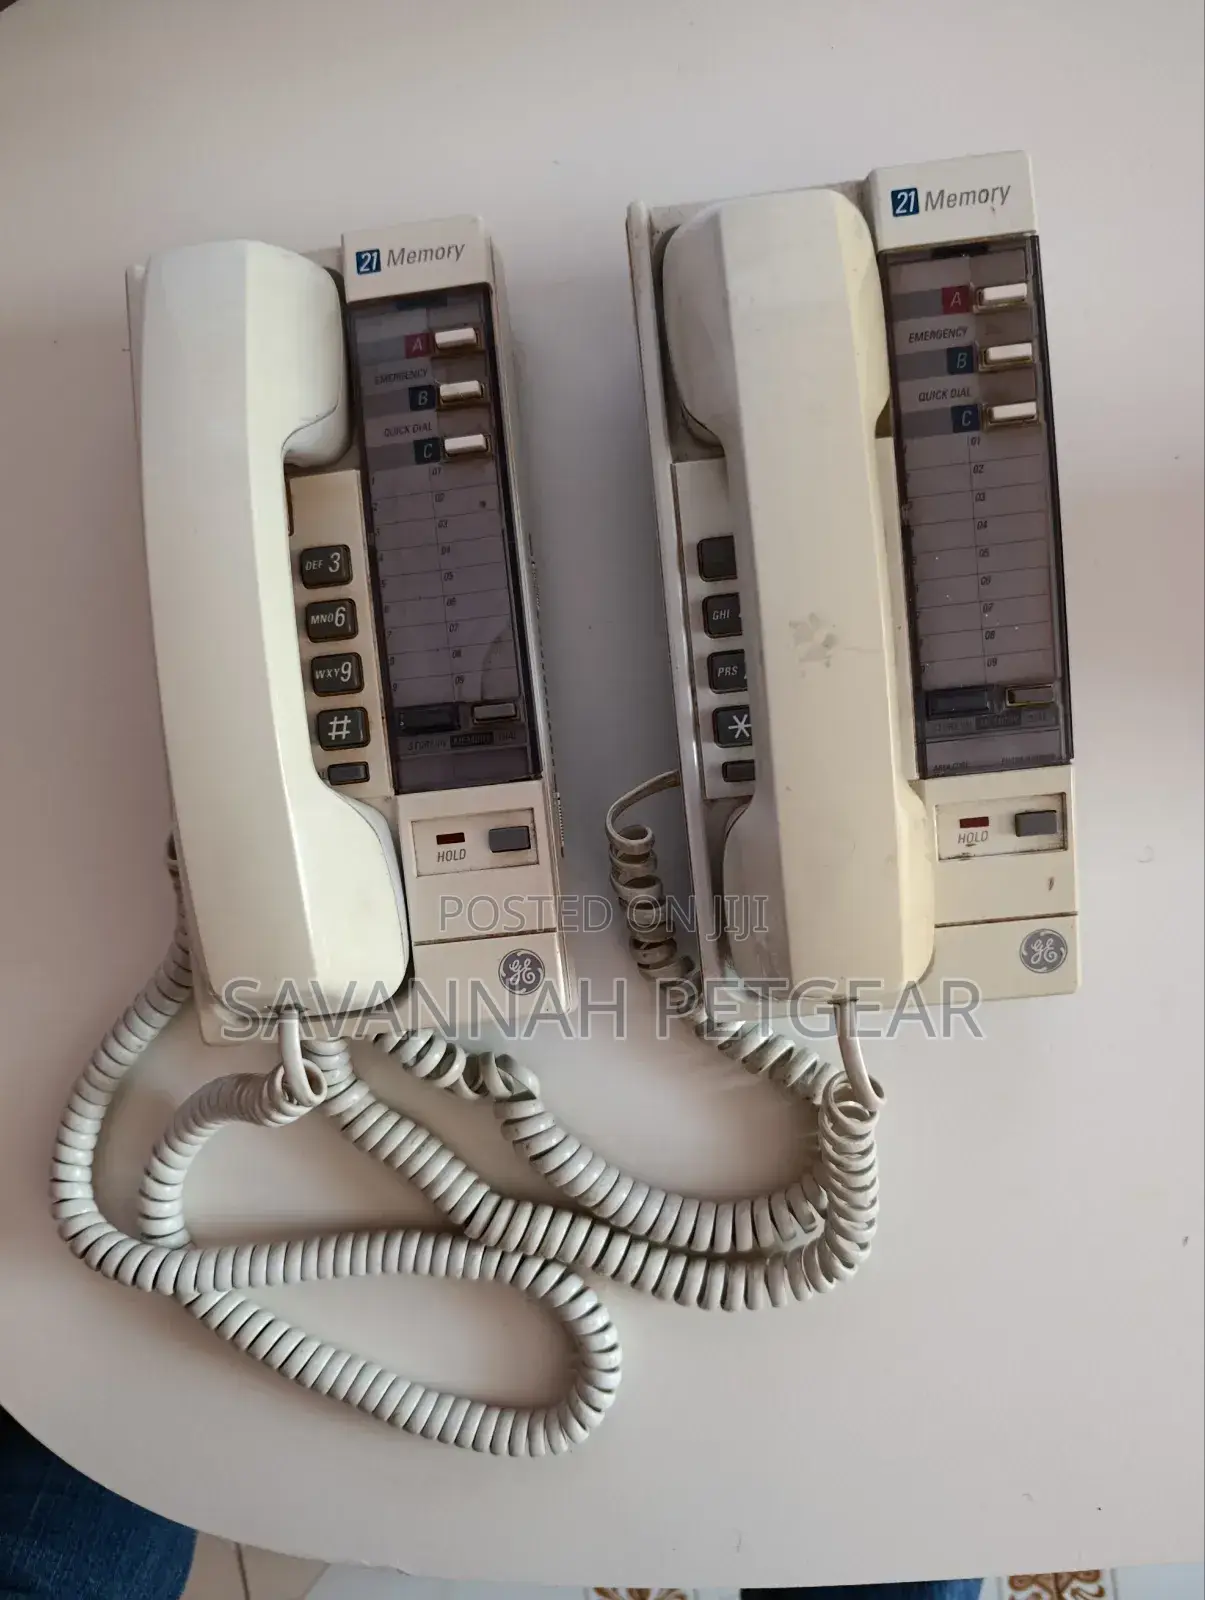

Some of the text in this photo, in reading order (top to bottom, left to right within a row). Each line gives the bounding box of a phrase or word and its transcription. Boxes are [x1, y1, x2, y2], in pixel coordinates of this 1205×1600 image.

[895, 184, 1011, 214] 21 Memory
[359, 244, 465, 273] 21 Memory
[950, 291, 962, 308] A
[908, 326, 968, 344] EMERGENCY
[411, 337, 423, 353] A
[956, 352, 967, 368] B
[374, 368, 428, 386] EMERGENCY
[417, 390, 428, 406] B
[918, 386, 971, 402] QUICK DIAL
[961, 410, 972, 427] C
[384, 422, 433, 437] QUICK DIAL
[423, 443, 433, 459] C
[305, 552, 341, 573] DEF 3
[310, 606, 346, 628] MNO 6
[712, 608, 730, 621] GHI
[315, 661, 352, 682] WXY 9
[717, 665, 738, 677] PRS
[958, 830, 989, 845] HOLD
[437, 848, 466, 862] HOLD
